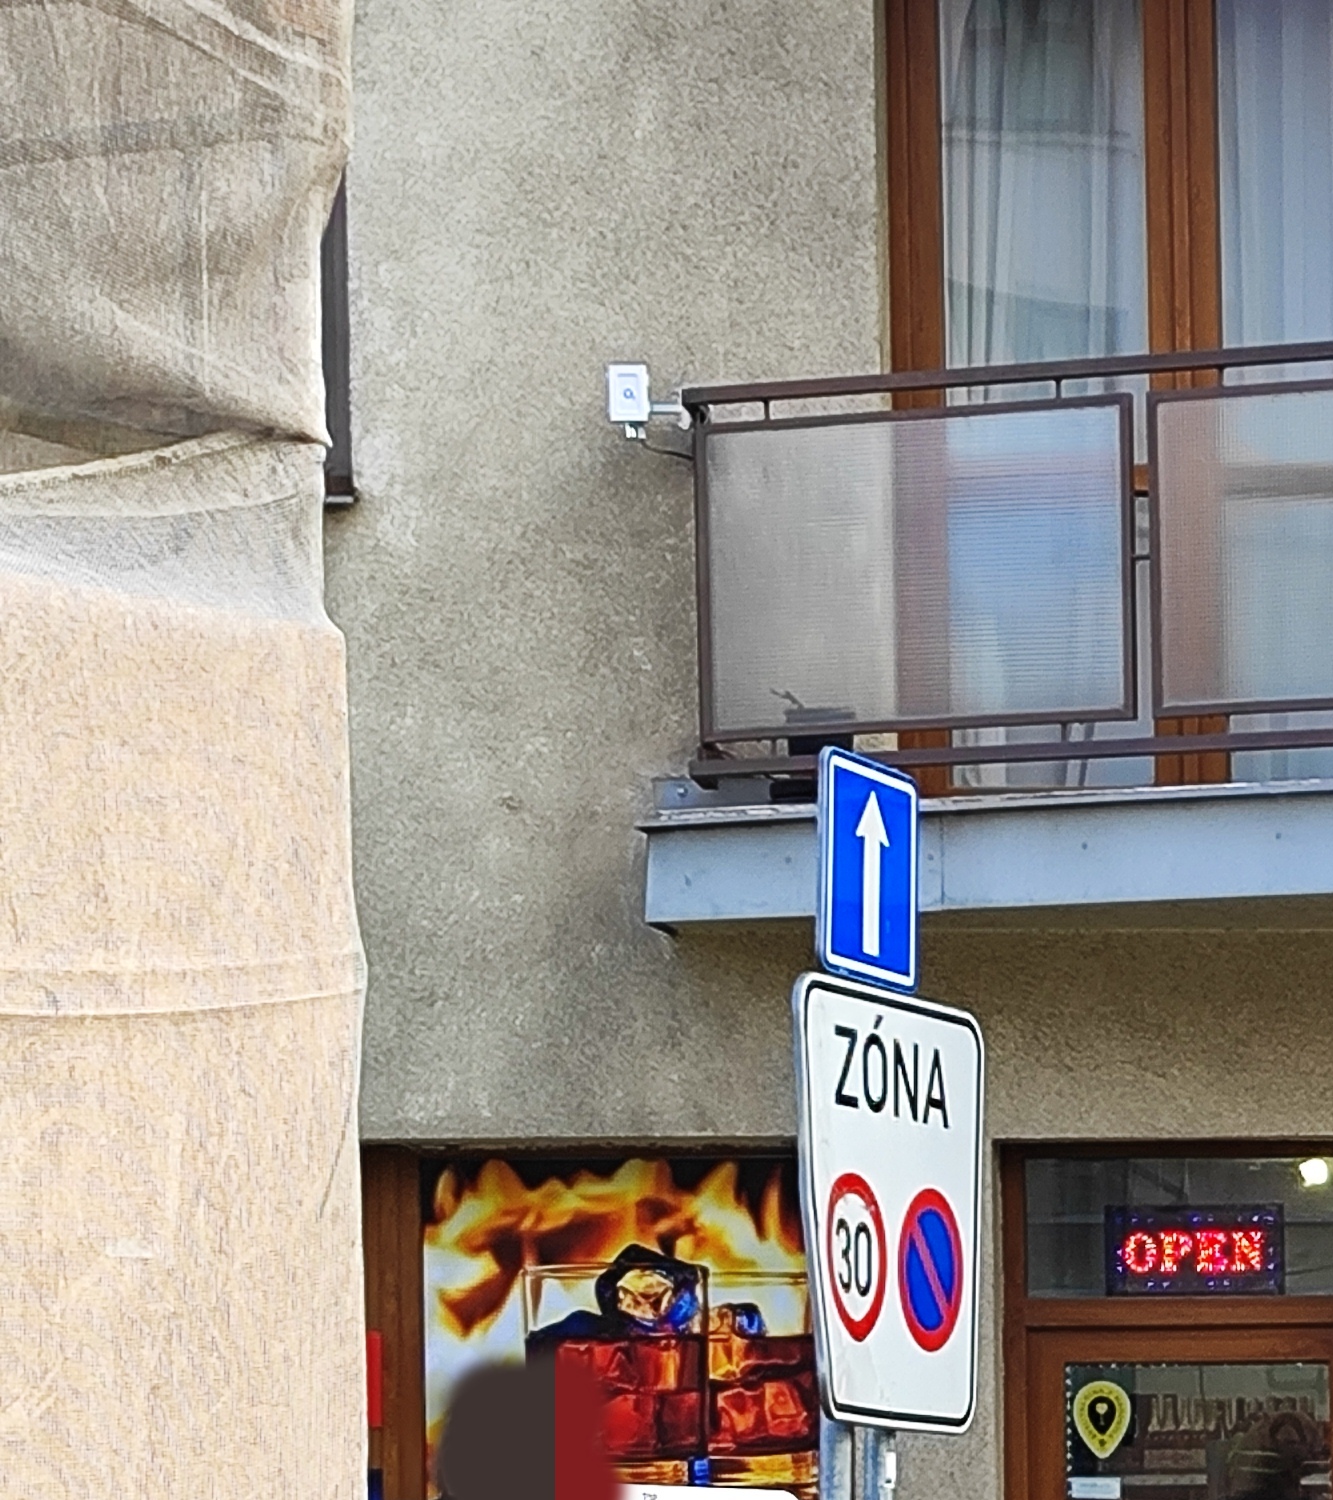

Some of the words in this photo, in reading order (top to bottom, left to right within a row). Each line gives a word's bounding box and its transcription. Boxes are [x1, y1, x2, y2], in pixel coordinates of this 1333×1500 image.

[833, 1014, 951, 1130] ZÓNA
[835, 1217, 873, 1298] 30
[1123, 1230, 1265, 1276] OPEN
